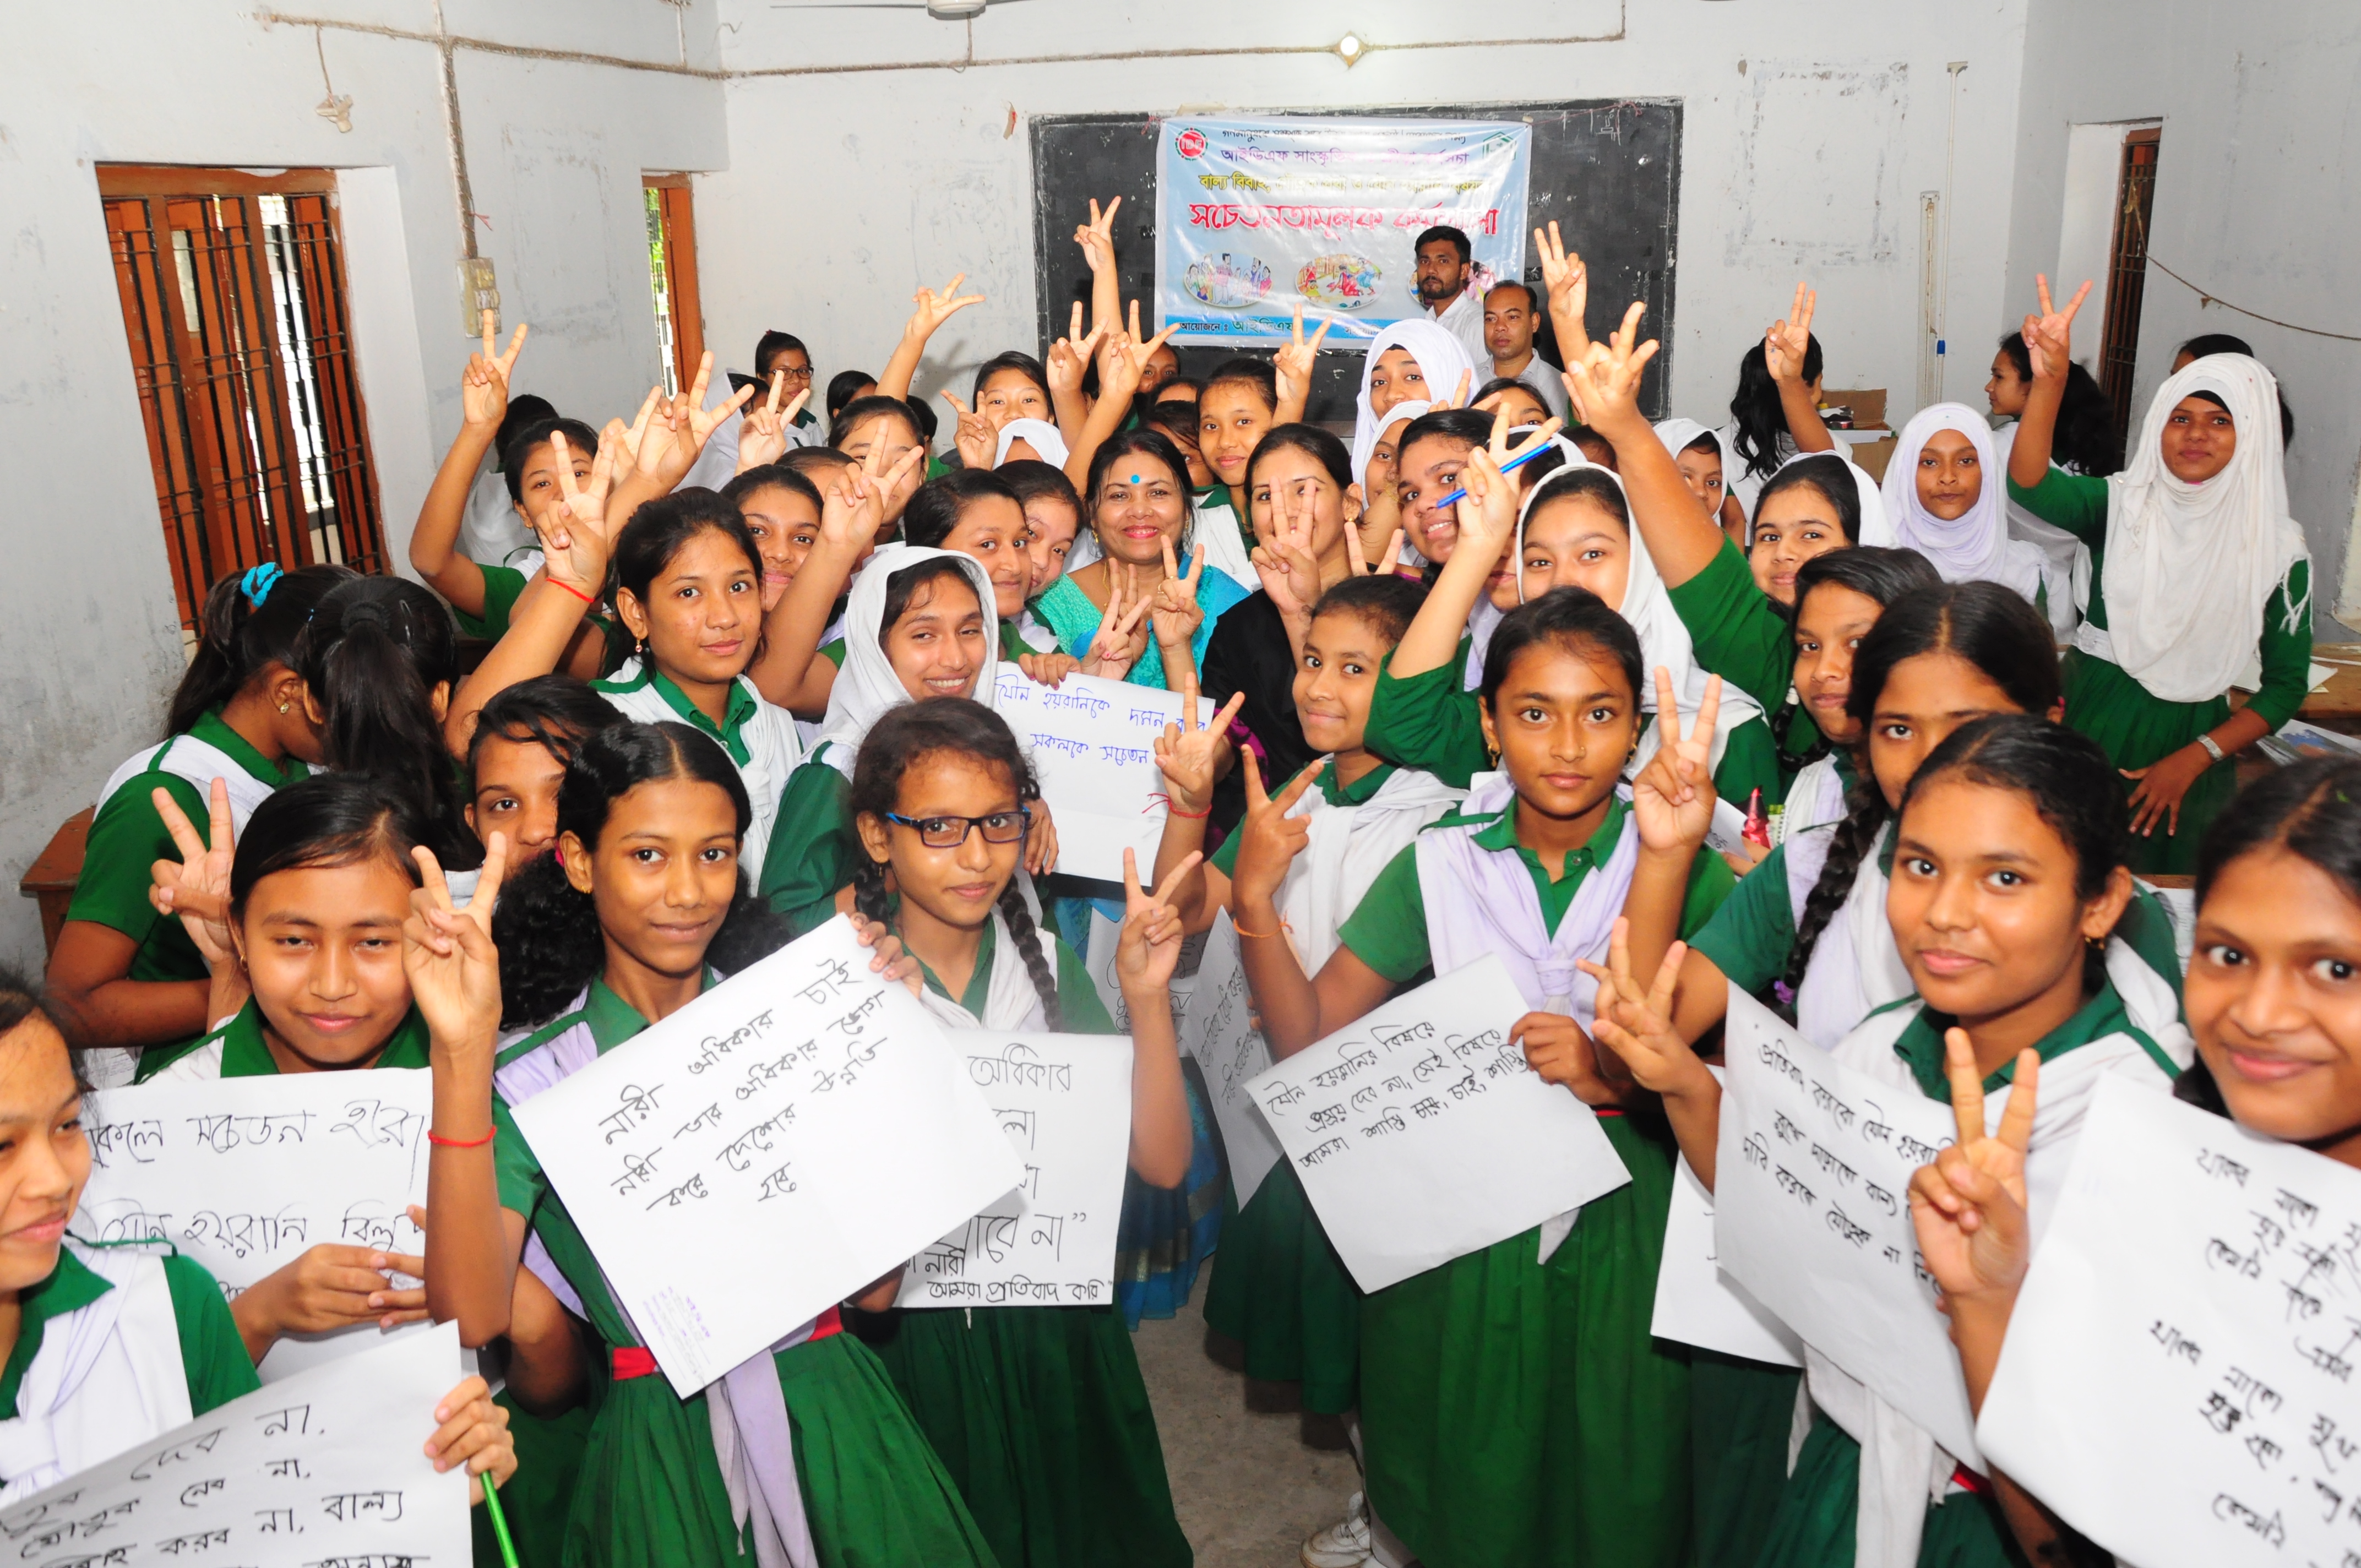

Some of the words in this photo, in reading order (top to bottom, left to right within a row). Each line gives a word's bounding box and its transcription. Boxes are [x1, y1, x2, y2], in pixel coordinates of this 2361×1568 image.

[1221, 146, 1290, 163] আইডিএফ
[1198, 173, 1229, 190] বাল্য
[1189, 203, 1383, 241] সচেতনতামূলক
[1099, 745, 1149, 766] সচেতন
[599, 1084, 664, 1146] নারী
[688, 1008, 774, 1074] অধিকার
[793, 958, 864, 1004] চাই
[967, 1043, 1072, 1092] অধিকার
[736, 1039, 818, 1101] অধিকার
[1263, 1081, 1305, 1116] যৌন
[758, 1162, 797, 1202] হবে
[927, 1280, 981, 1300] আমরা
[321, 1490, 404, 1522] বাল্য
